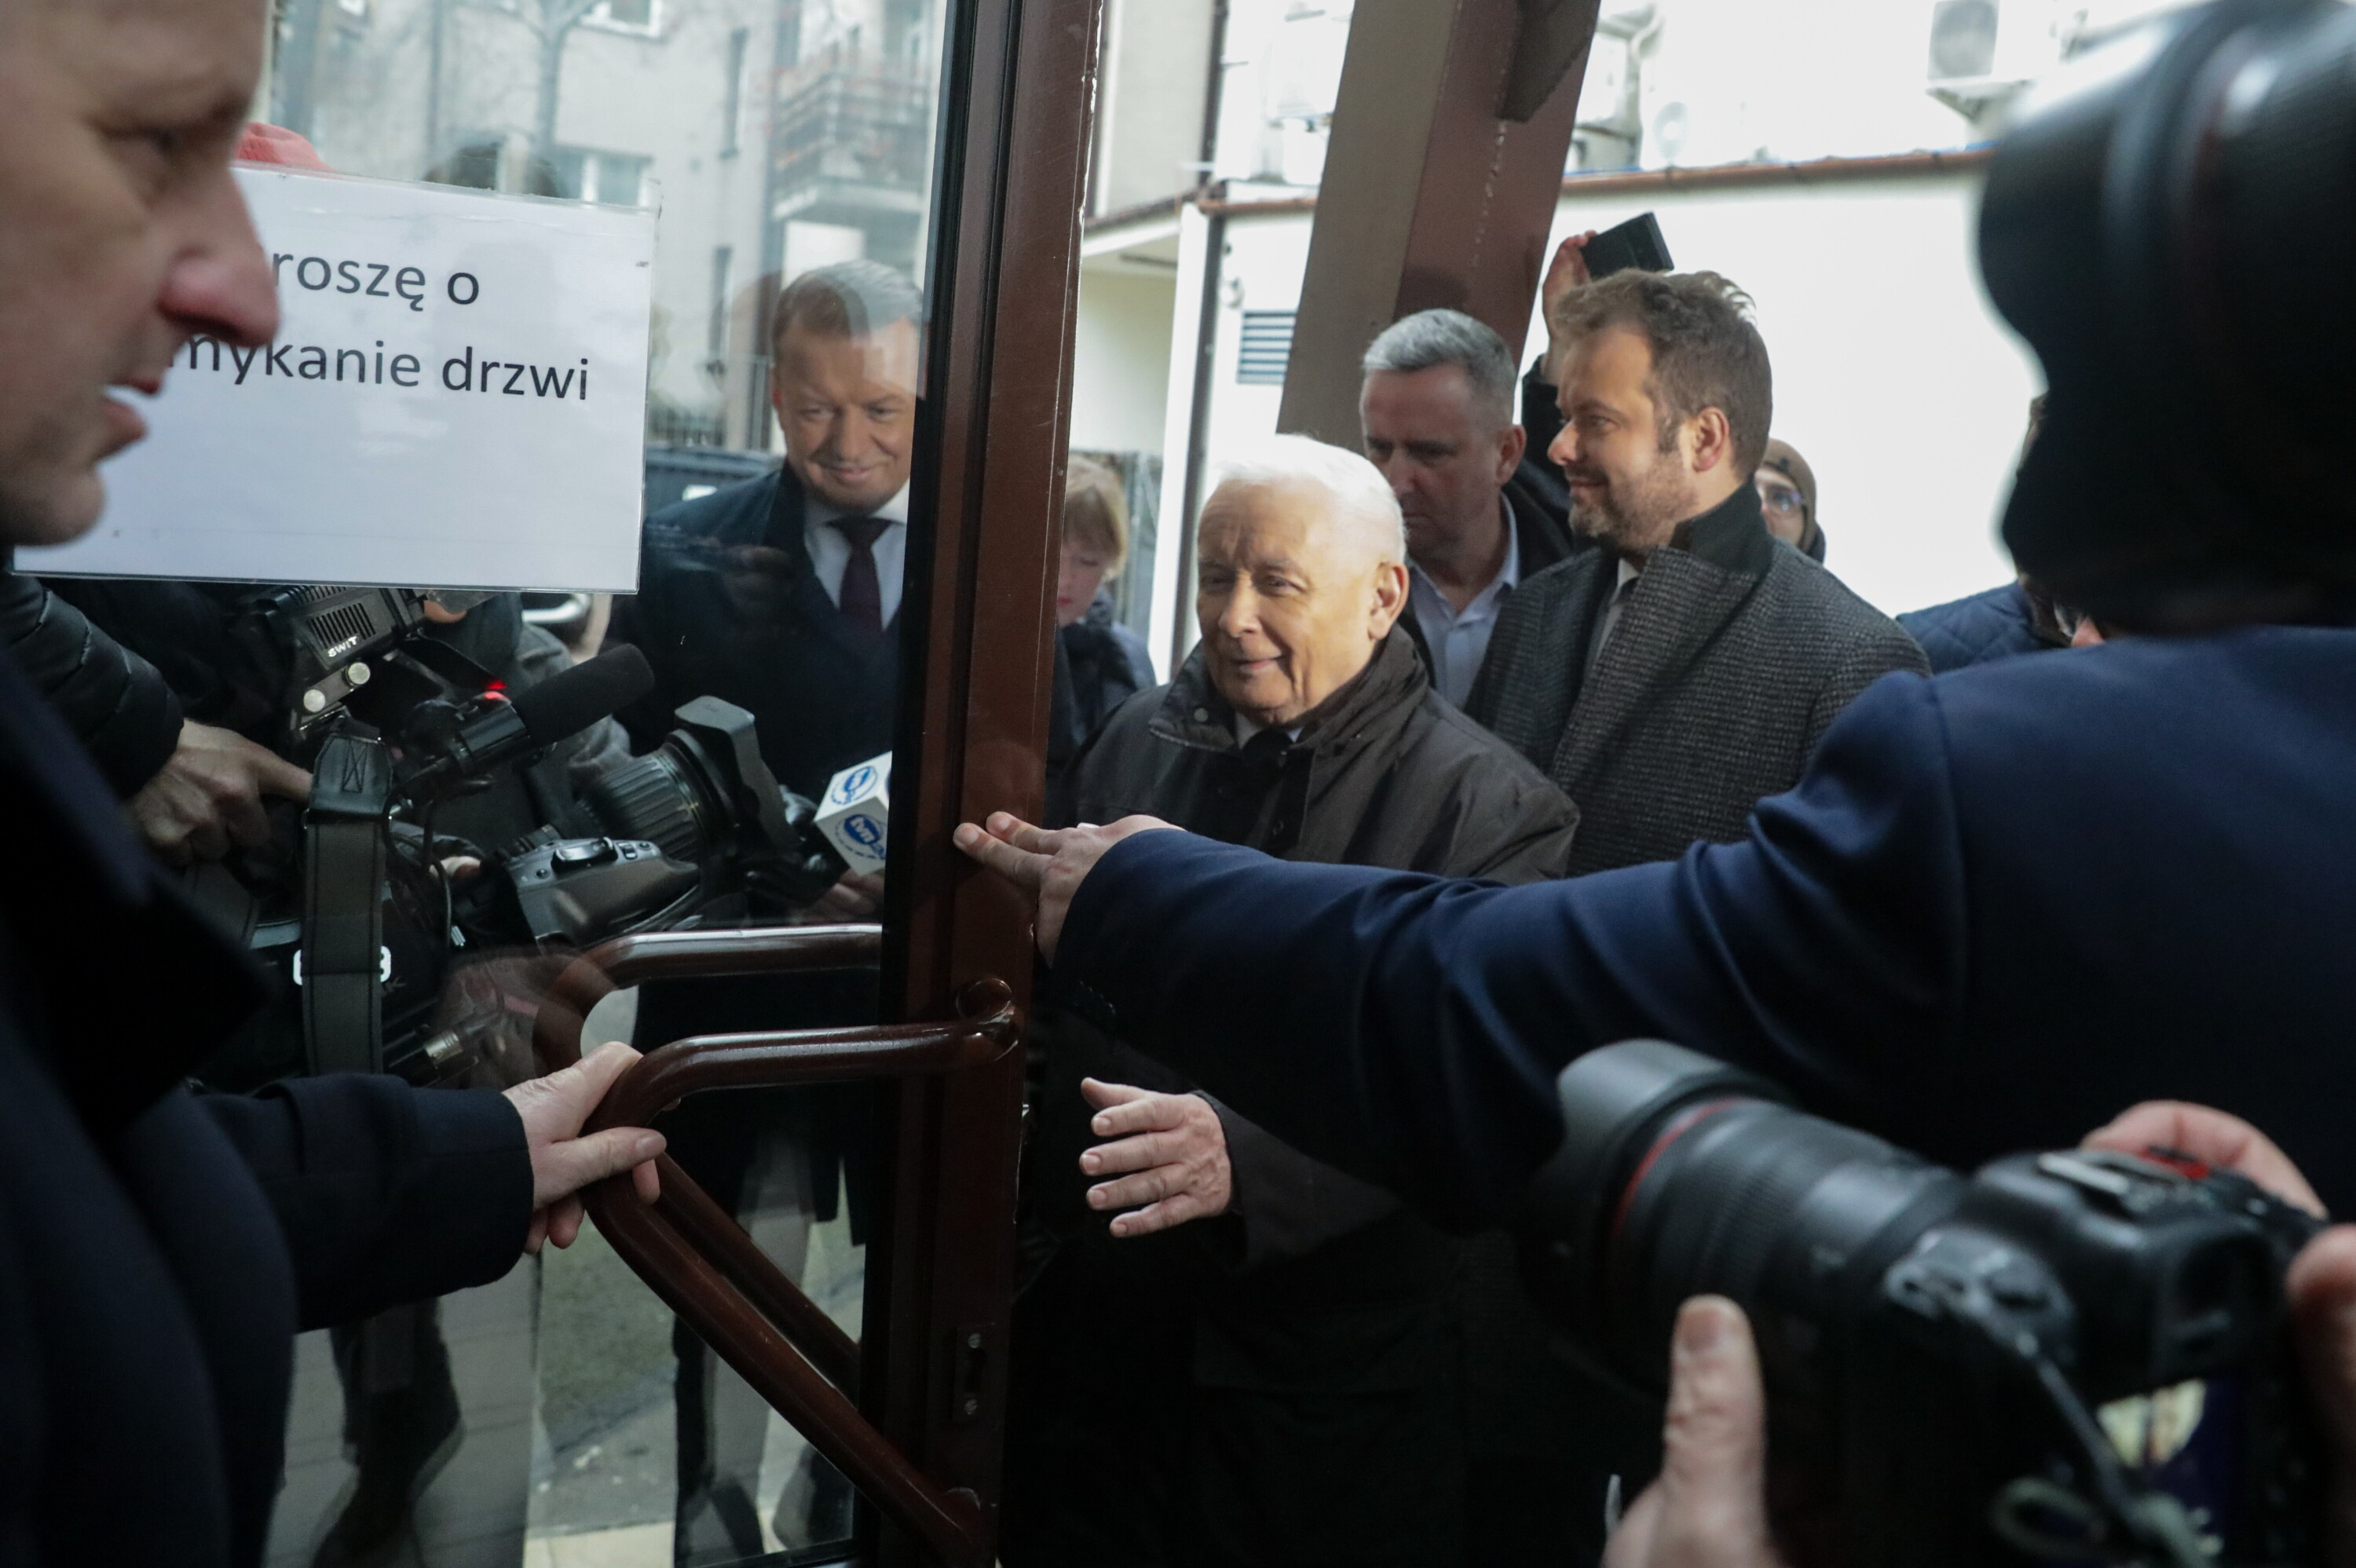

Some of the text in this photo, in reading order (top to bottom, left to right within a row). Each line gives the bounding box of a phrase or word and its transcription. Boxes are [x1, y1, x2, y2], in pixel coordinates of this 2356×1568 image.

[273, 253, 479, 311] roszę o
[442, 345, 588, 400] drzwi
[327, 635, 357, 657] SWIT
